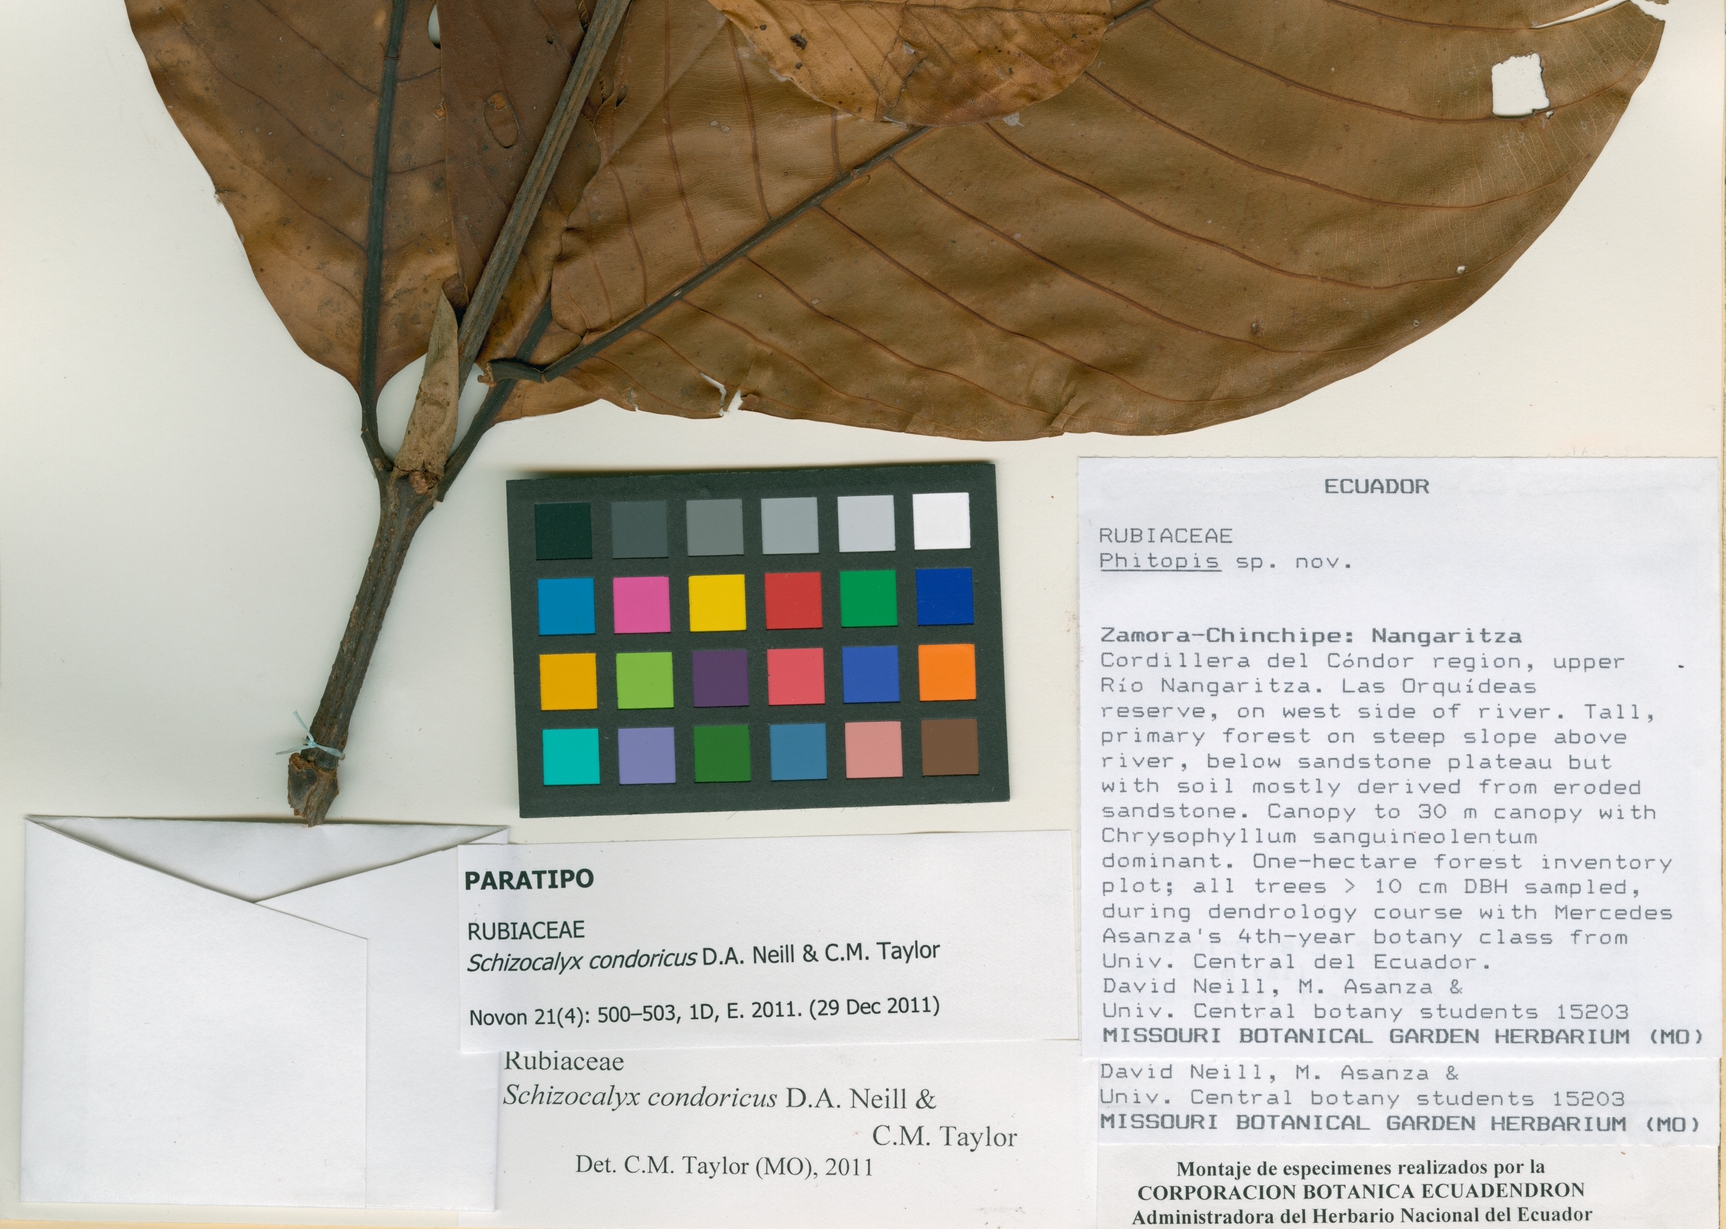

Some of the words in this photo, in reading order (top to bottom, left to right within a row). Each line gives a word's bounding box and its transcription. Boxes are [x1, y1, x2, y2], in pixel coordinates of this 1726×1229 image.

[1325, 479, 1429, 494] ECUADOR
[1100, 528, 1233, 543] RUBIACEAE
[1100, 553, 1222, 572] Phitopis
[1236, 557, 1275, 572] sp.
[1296, 557, 1350, 568] nov.
[1101, 627, 1352, 647] Zamora-Chinchipe:
[1372, 628, 1522, 647] Nangaritza
[1101, 652, 1250, 668] Cordillera
[1268, 653, 1308, 668] del
[1328, 653, 1414, 668] Cóndor
[1433, 653, 1533, 672] region,
[1554, 658, 1625, 673] upper
[1101, 677, 1143, 692] Río
[1162, 678, 1321, 697] Nangaritza.
[1342, 678, 1385, 693] Las
[1401, 678, 1536, 697] Orquídeas
[1101, 707, 1217, 722] reserve,
[1238, 707, 1264, 718] on
[1283, 703, 1341, 718] west
[1358, 703, 1416, 718] side
[1433, 703, 1461, 719] of
[1479, 703, 1563, 719] river.
[1584, 704, 1653, 723] Tall,
[1102, 727, 1205, 747] primary
[1223, 728, 1311, 743] forest
[1328, 732, 1354, 743] on
[1373, 728, 1445, 747] steep
[1464, 728, 1536, 747] slope
[1554, 729, 1627, 744] above
[1102, 803, 1247, 818] sandstone.
[1268, 803, 1356, 822] Canopy
[1375, 804, 1400, 819] to
[1419, 804, 1447, 819] 30
[1464, 808, 1477, 819] m
[1494, 808, 1582, 823] canopy
[1599, 805, 1656, 819] with
[1102, 827, 1296, 847] Chrysophyllum
[1313, 829, 1537, 848] sanguineolentum
[1102, 853, 1232, 869] dominant.
[1253, 853, 1416, 869] One-hectare
[1434, 854, 1522, 869] forest
[1542, 854, 1672, 873] inventory
[465, 868, 594, 890] PARATIPO
[468, 919, 585, 940] RUBIACEAE
[1103, 928, 1221, 943] Asanza's
[1239, 928, 1355, 948] 4th-year
[1374, 929, 1462, 948] botany
[1480, 929, 1553, 944] class
[1570, 929, 1627, 945] from
[467, 952, 584, 975] Schizocalyx
[589, 949, 698, 969] condoricus
[703, 947, 744, 965] D.A.
[753, 944, 794, 964] Neill
[803, 944, 819, 962] &
[825, 943, 869, 962] C.M.
[876, 940, 940, 964] Taylor
[1103, 978, 1175, 993] David
[1194, 978, 1278, 997] Neill,
[1299, 979, 1323, 994] M.
[1344, 979, 1432, 994] Asanza
[1450, 979, 1462, 994] &
[470, 1010, 527, 1026] Novon
[535, 1007, 589, 1028] 21(4):
[690, 1003, 719, 1023] 1D,
[727, 1002, 744, 1019] E.
[752, 1001, 802, 1018] 2011.
[810, 999, 839, 1020] (29
[847, 999, 881, 1015] Dec
[887, 995, 939, 1017] 2011)
[1103, 1002, 1173, 1018] Univ.
[1194, 1003, 1294, 1018] Central
[1314, 1003, 1402, 1022] botany
[1420, 1004, 1538, 1019] students
[1558, 1004, 1628, 1019] 15203
[1103, 1027, 1220, 1043] MISSOURI
[1239, 1028, 1373, 1044] BOTANICAL
[1390, 1028, 1479, 1044] GARDEN
[1495, 1029, 1630, 1044] HERBARIUM
[1651, 1029, 1702, 1044] (MO)
[504, 1050, 624, 1071] Rubiaceae
[503, 1084, 640, 1111] Schizocalyx
[648, 1086, 777, 1108] condoricus
[786, 1087, 840, 1108] D.A.
[849, 1088, 907, 1109] Neill
[915, 1089, 937, 1109] &
[1100, 1113, 1217, 1129] MISSOURI
[1236, 1114, 1370, 1130] BOTANICAL
[1387, 1115, 1475, 1131] GARDEN
[1491, 1116, 1626, 1132] HERBARIUM
[1647, 1117, 1699, 1132] (MO)
[873, 1125, 930, 1146] C.M.
[939, 1126, 1018, 1152] Taylor
[576, 1155, 616, 1173] Det.
[624, 1155, 674, 1174] C.M.
[682, 1156, 749, 1179] Taylor
[756, 1157, 818, 1180] (MO),
[825, 1158, 872, 1176] 2011
[1176, 1161, 1251, 1180] Montaje
[1257, 1161, 1277, 1176] de
[1283, 1160, 1391, 1180] especimenes
[1398, 1159, 1487, 1175] realizados
[1494, 1163, 1524, 1178] por
[1530, 1159, 1545, 1173] la
[1138, 1184, 1296, 1201] CORPORACION
[1303, 1184, 1415, 1199] BOTANICA
[1421, 1182, 1584, 1198] ECUADENDRON
[1132, 1209, 1274, 1225] Administradora
[1280, 1209, 1306, 1224] del
[1312, 1208, 1394, 1223] Herbario
[1401, 1207, 1479, 1223] Nacional
[1485, 1207, 1511, 1222] del
[1517, 1206, 1593, 1222] Ecuador
